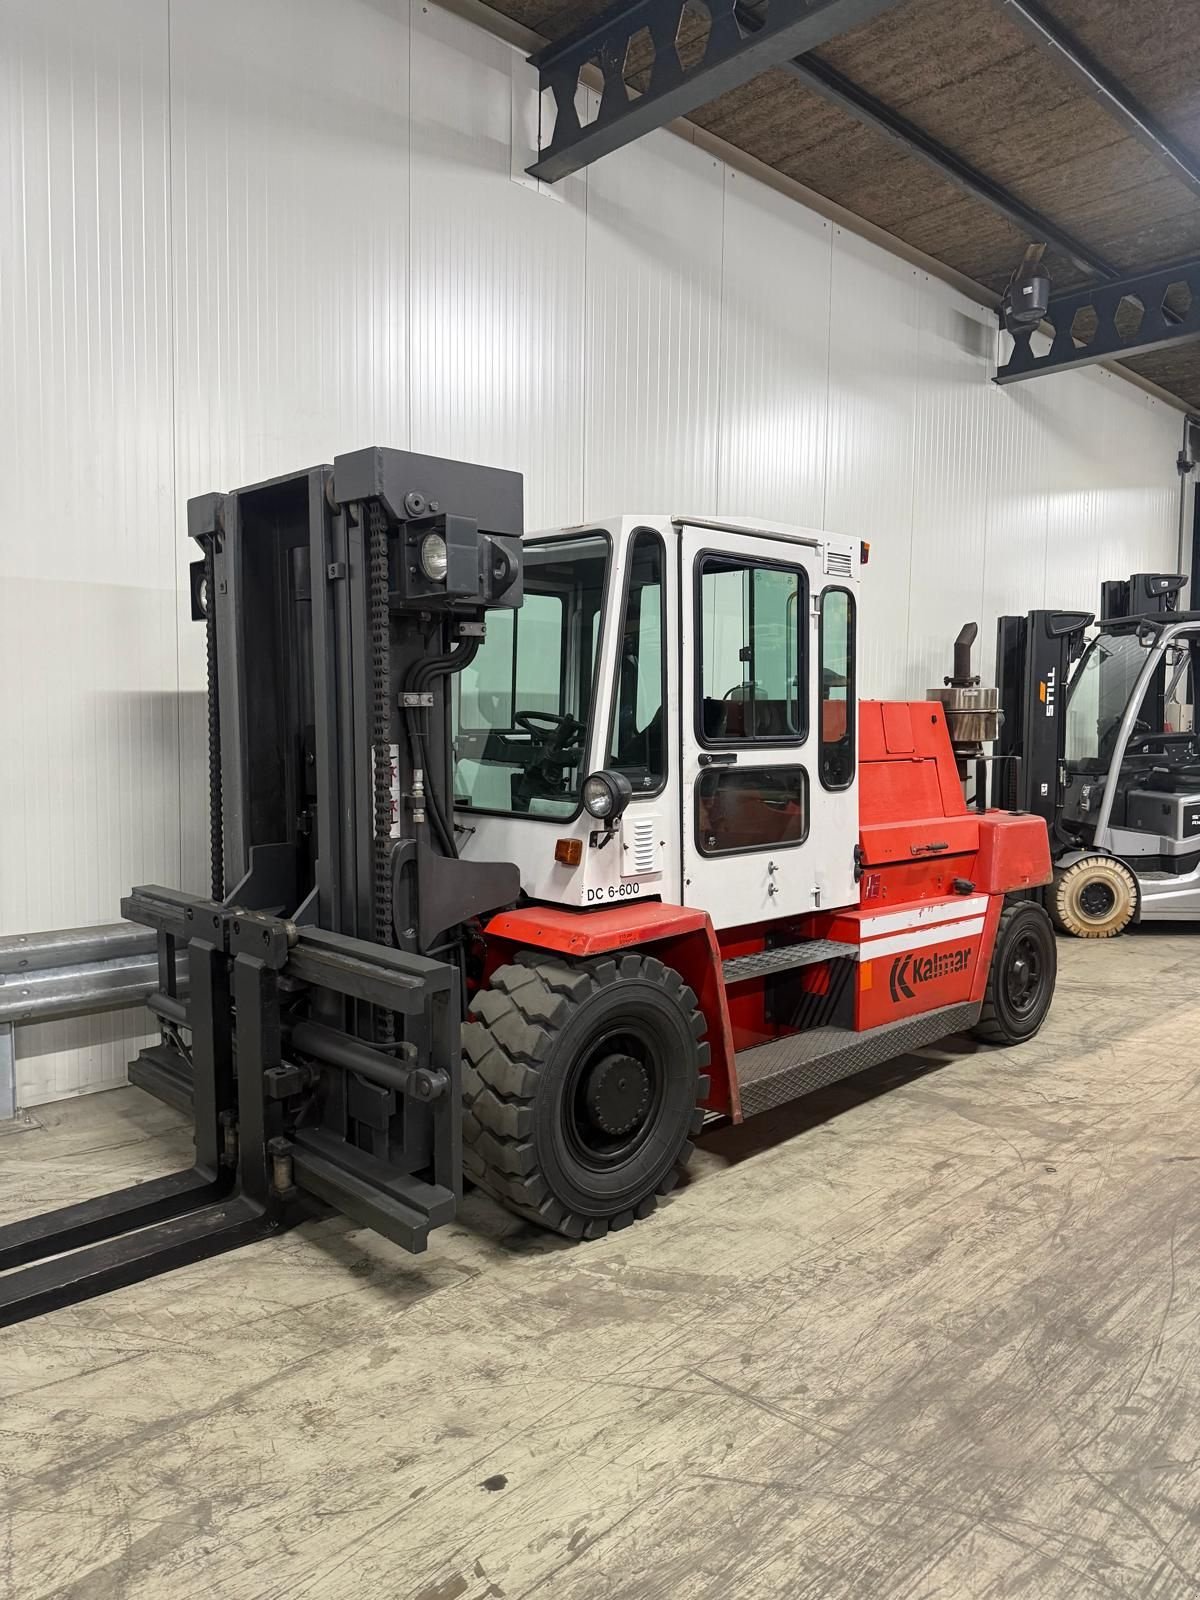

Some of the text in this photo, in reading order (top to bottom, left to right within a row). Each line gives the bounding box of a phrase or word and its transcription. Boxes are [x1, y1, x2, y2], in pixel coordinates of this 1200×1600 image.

[1046, 667, 1056, 717] STILL
[587, 882, 640, 901] DC 6-600
[912, 947, 972, 984] Kalmar
